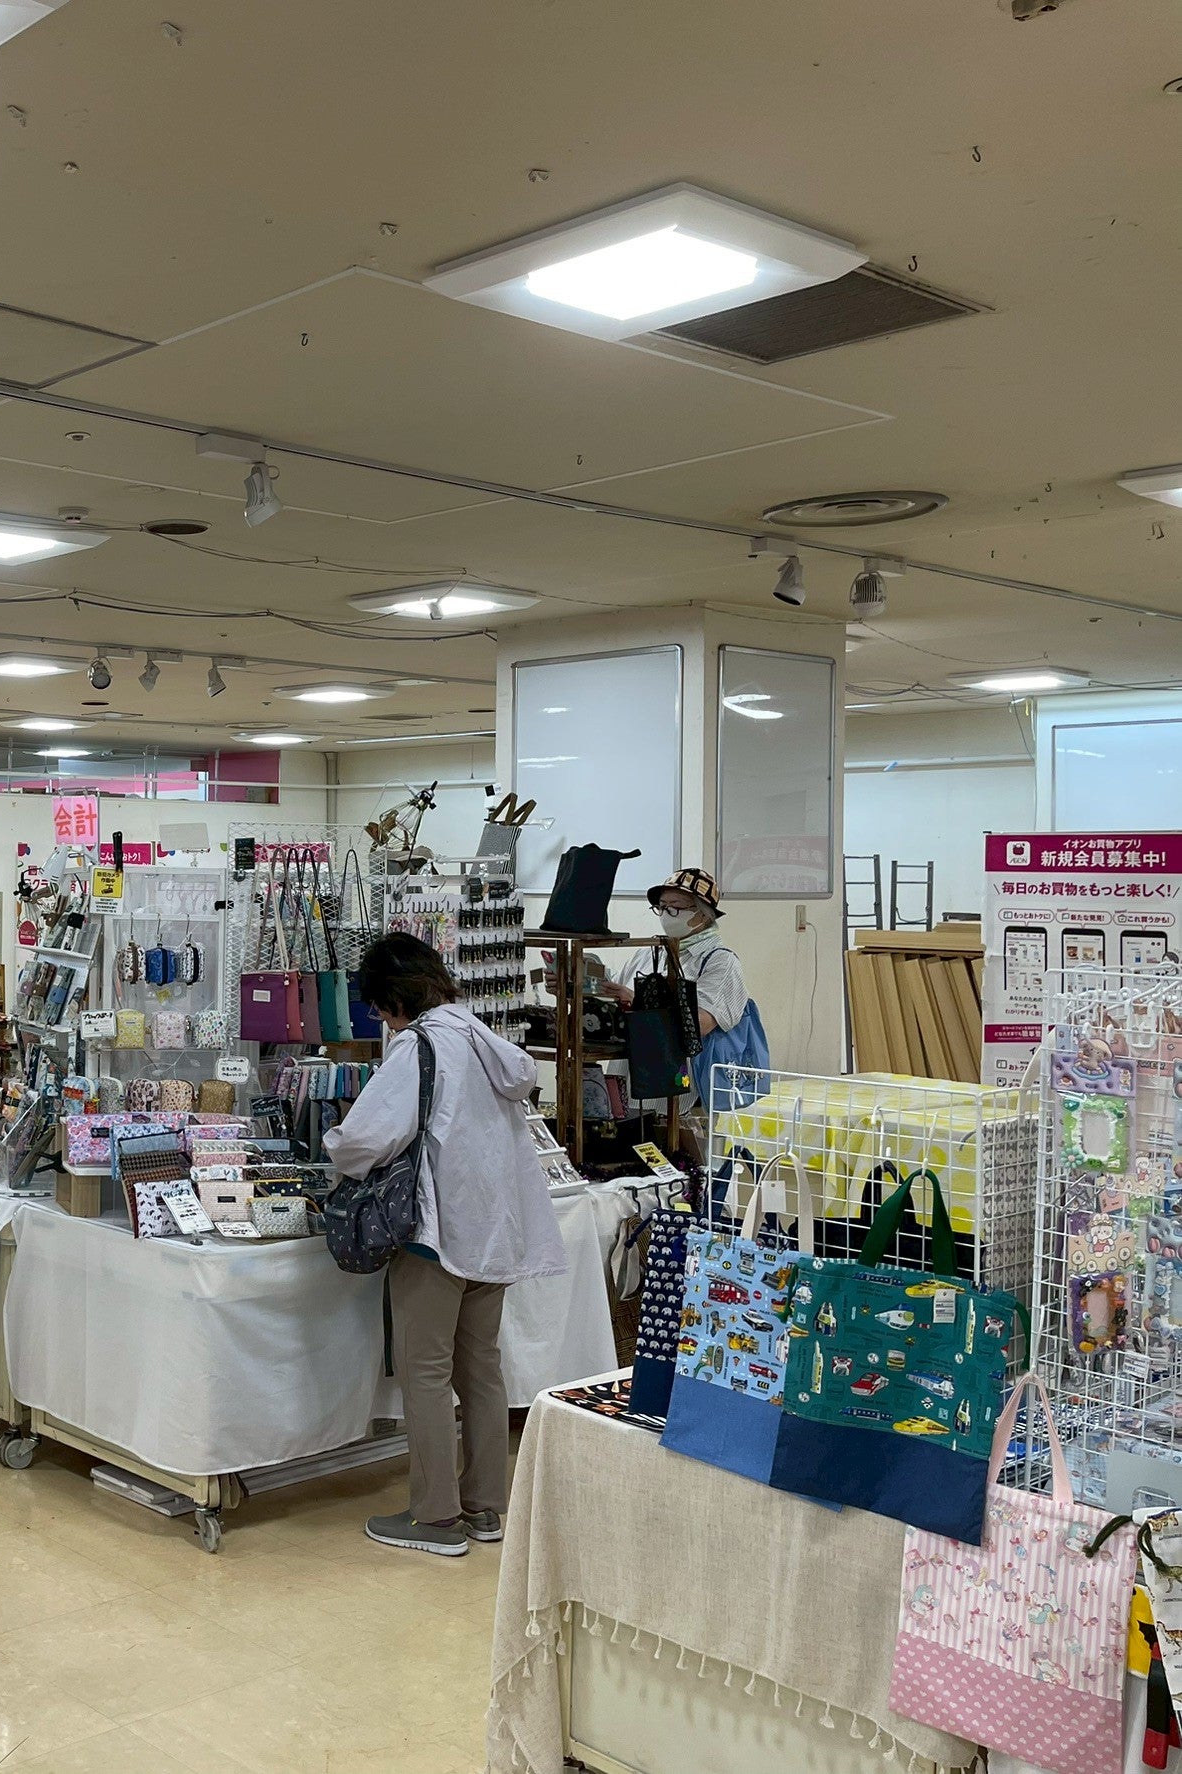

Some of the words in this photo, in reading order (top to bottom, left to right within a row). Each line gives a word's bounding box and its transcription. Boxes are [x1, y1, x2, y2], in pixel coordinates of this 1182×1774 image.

[55, 803, 97, 836] 会計
[1063, 839, 1141, 849] イオンお買物アプリ
[1041, 850, 1166, 868] 新規会員募集中!
[1002, 882, 1171, 898] 毎日のお買物をもっと楽しく!
[1127, 916, 1170, 924] これ買うかも!
